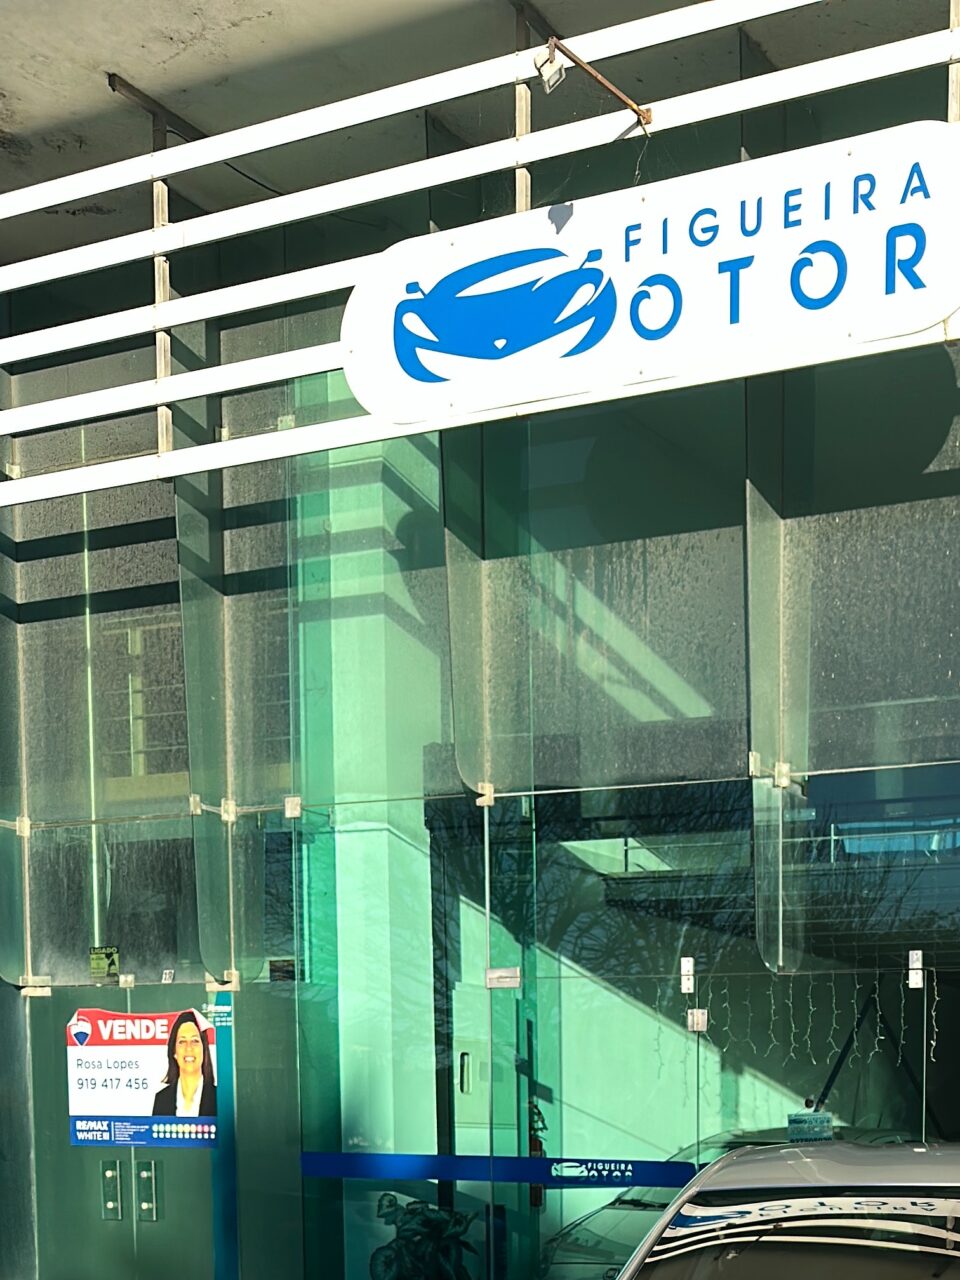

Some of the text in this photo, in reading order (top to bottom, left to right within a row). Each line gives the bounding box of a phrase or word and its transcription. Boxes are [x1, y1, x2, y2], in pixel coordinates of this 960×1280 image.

[624, 161, 930, 262] FIGUEIRA
[90, 946, 118, 954] LIGADO
[97, 1018, 169, 1041] VENDE
[76, 1058, 140, 1071] Rosa Lopes
[76, 1077, 149, 1090] 919 417 456
[76, 1131, 103, 1141] WHITE
[587, 1162, 633, 1171] FIGUEIRA
